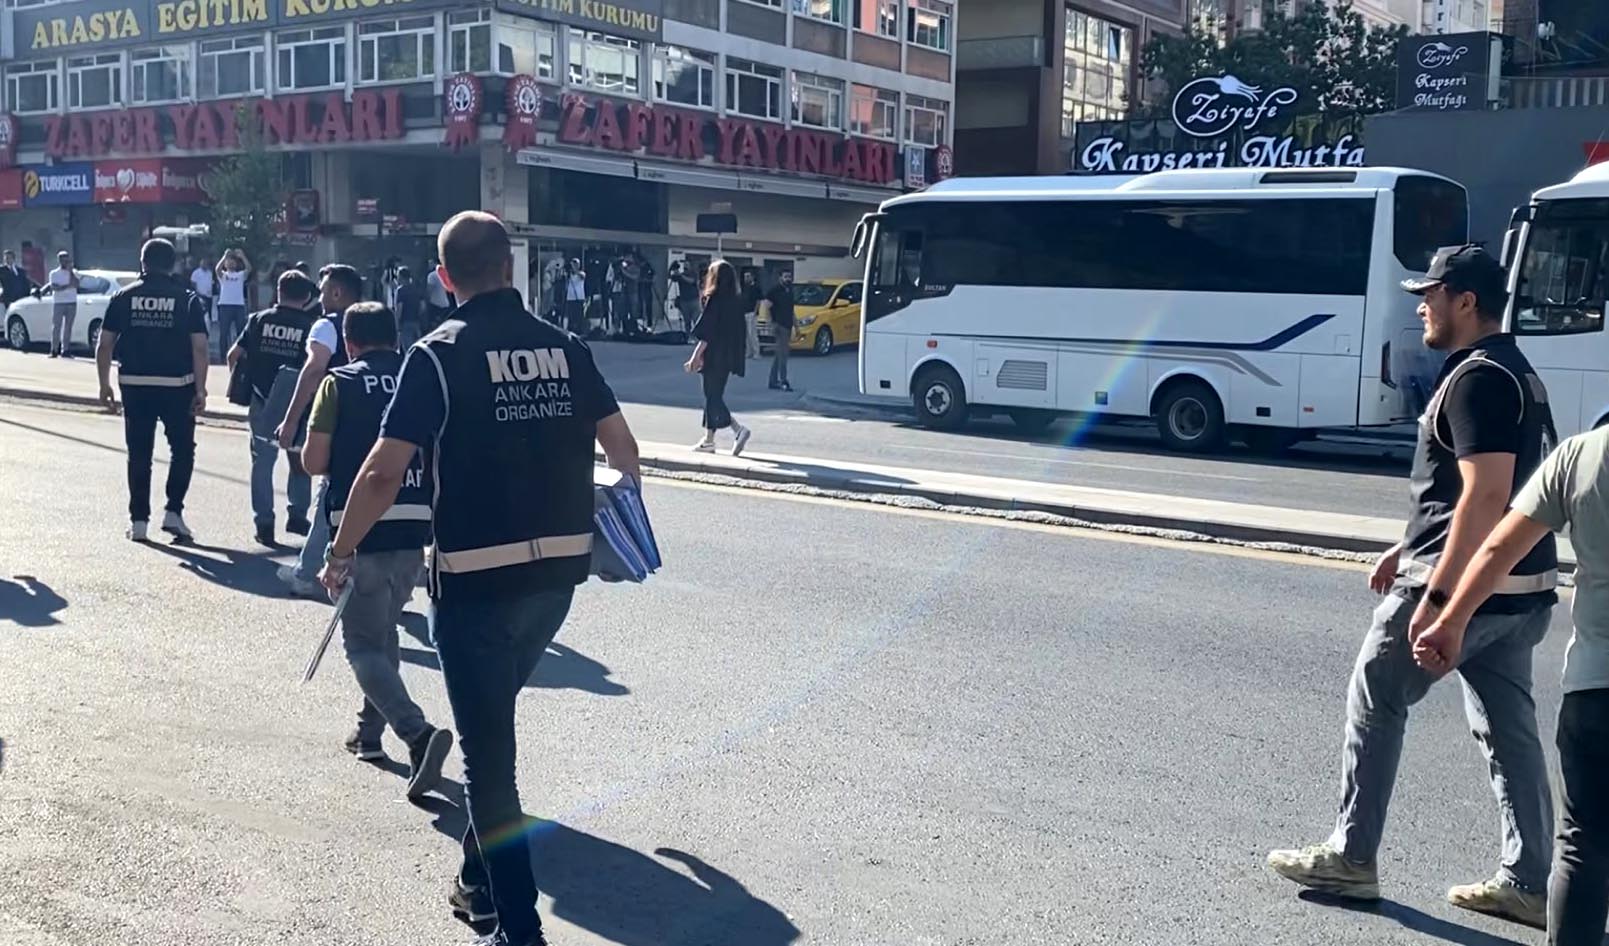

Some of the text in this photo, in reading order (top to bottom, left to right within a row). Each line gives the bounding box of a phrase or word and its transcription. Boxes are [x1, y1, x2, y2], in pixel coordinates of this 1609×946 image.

[31, 8, 141, 49] ARASYA
[579, 0, 658, 32] KURUMU
[1416, 73, 1466, 90] Kayseri
[1173, 77, 1297, 137] Ziyafe
[44, 107, 166, 160] ZAFER
[558, 94, 706, 160] ZAFER
[715, 117, 896, 185] YAYINLARI
[39, 173, 91, 192] TURKCELL
[131, 296, 176, 312] KOM
[262, 323, 304, 342] KOM
[486, 348, 570, 383] KOM
[495, 382, 571, 403] ANKARA
